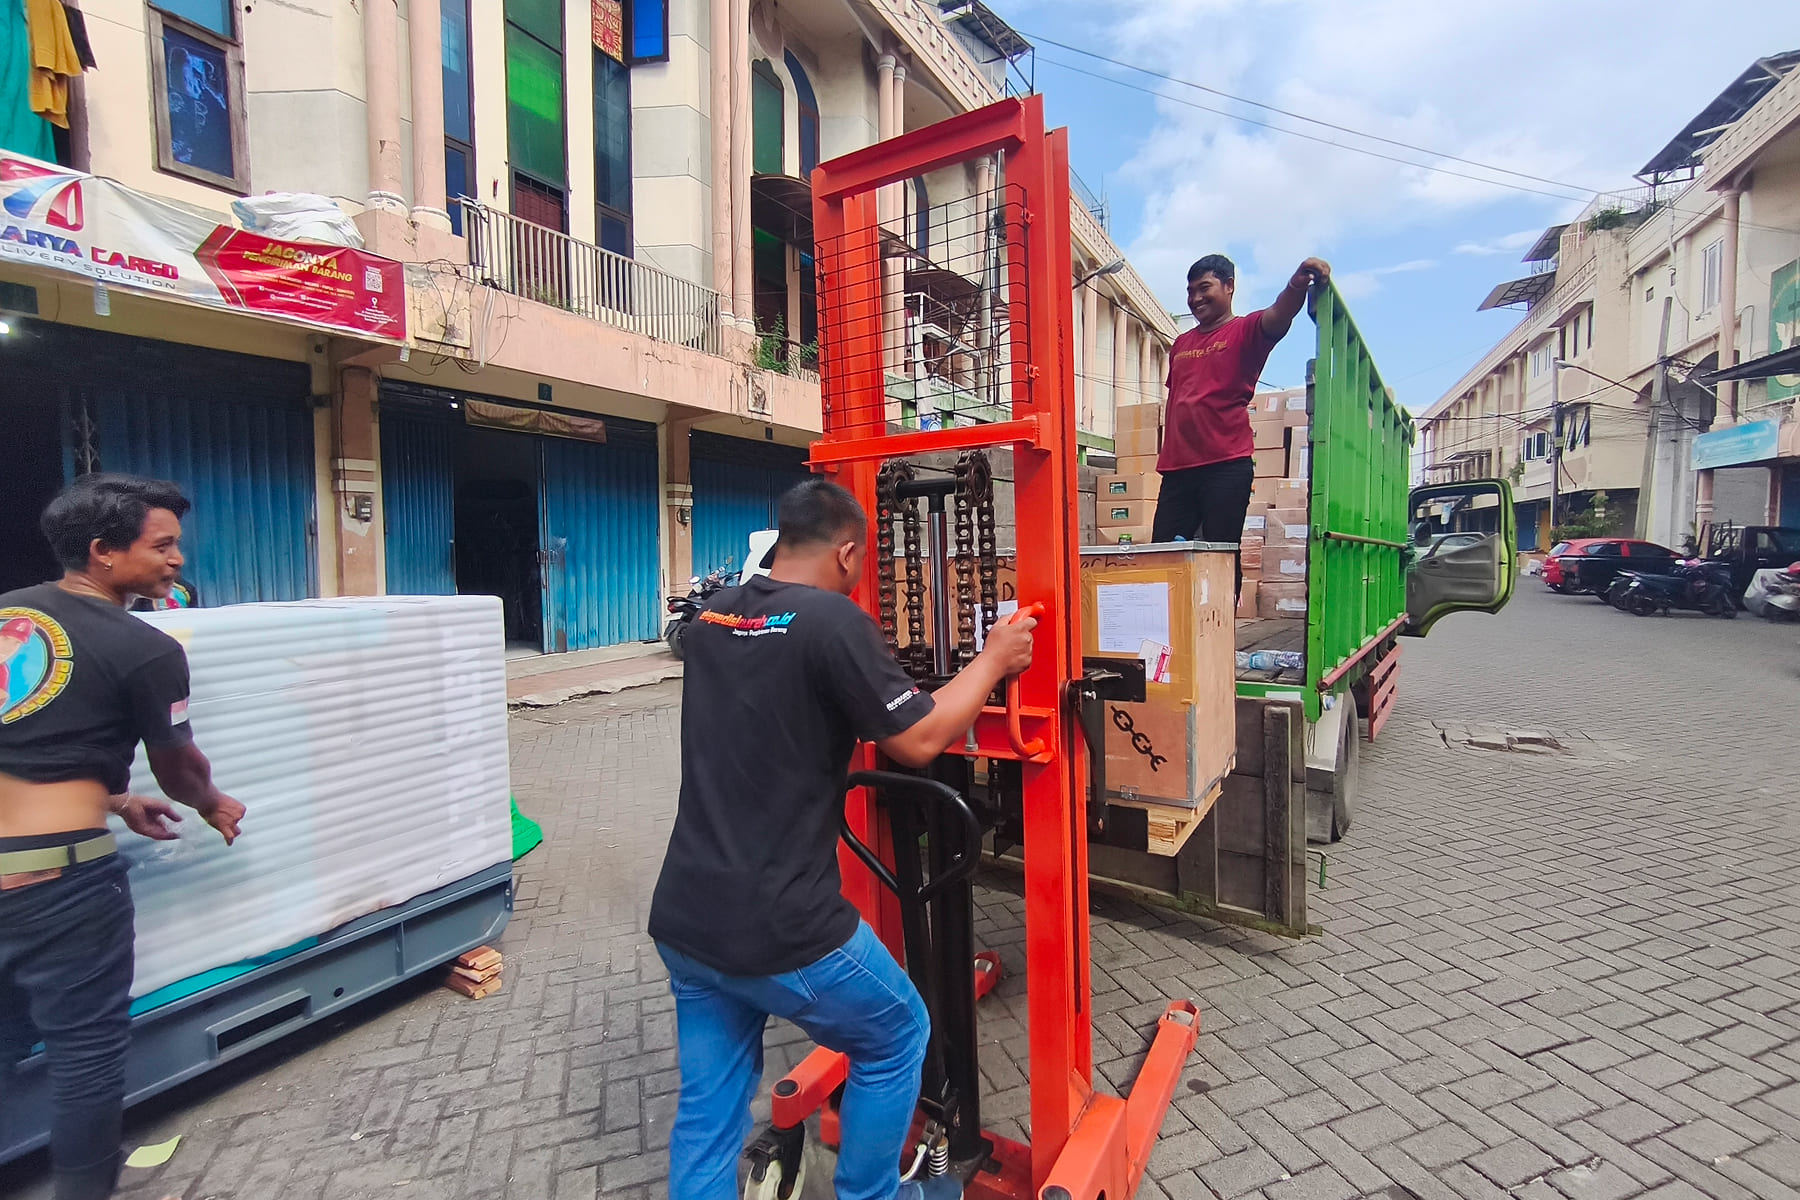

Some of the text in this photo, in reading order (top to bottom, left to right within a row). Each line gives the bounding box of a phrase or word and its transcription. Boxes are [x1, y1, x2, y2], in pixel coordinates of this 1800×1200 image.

[91, 246, 179, 280] CARGO
[262, 243, 337, 270] JAGONYA
[83, 263, 176, 290] SOLUTION
[311, 265, 353, 282] BARANG
